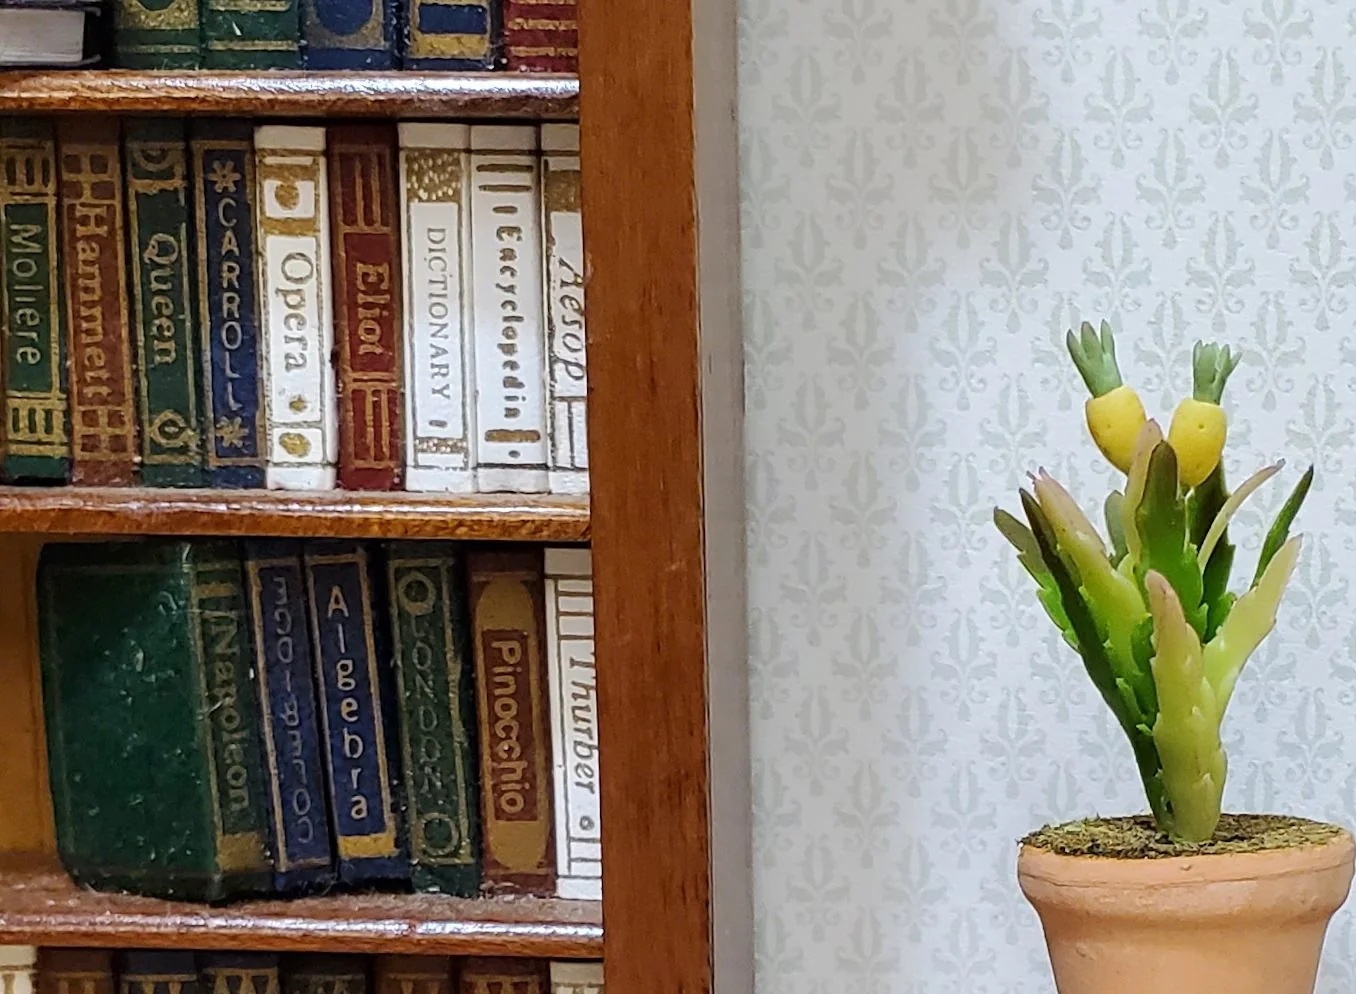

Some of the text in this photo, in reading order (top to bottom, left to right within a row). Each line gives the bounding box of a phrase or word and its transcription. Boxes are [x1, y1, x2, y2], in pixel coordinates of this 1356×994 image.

[75, 204, 112, 399] Hammett
[143, 232, 179, 364] Queen
[217, 198, 243, 411] CARROLL
[275, 252, 314, 373] Opera
[356, 261, 391, 356] Eliot
[427, 227, 451, 401] DICTIONARY
[495, 225, 526, 419] Encyclopedia
[552, 257, 586, 382] Aesop
[209, 621, 249, 812] Napoleon
[327, 584, 369, 820] Algebra
[410, 615, 443, 797] LONDON
[491, 639, 531, 814] Pinocchio
[569, 651, 600, 795] Thurber
